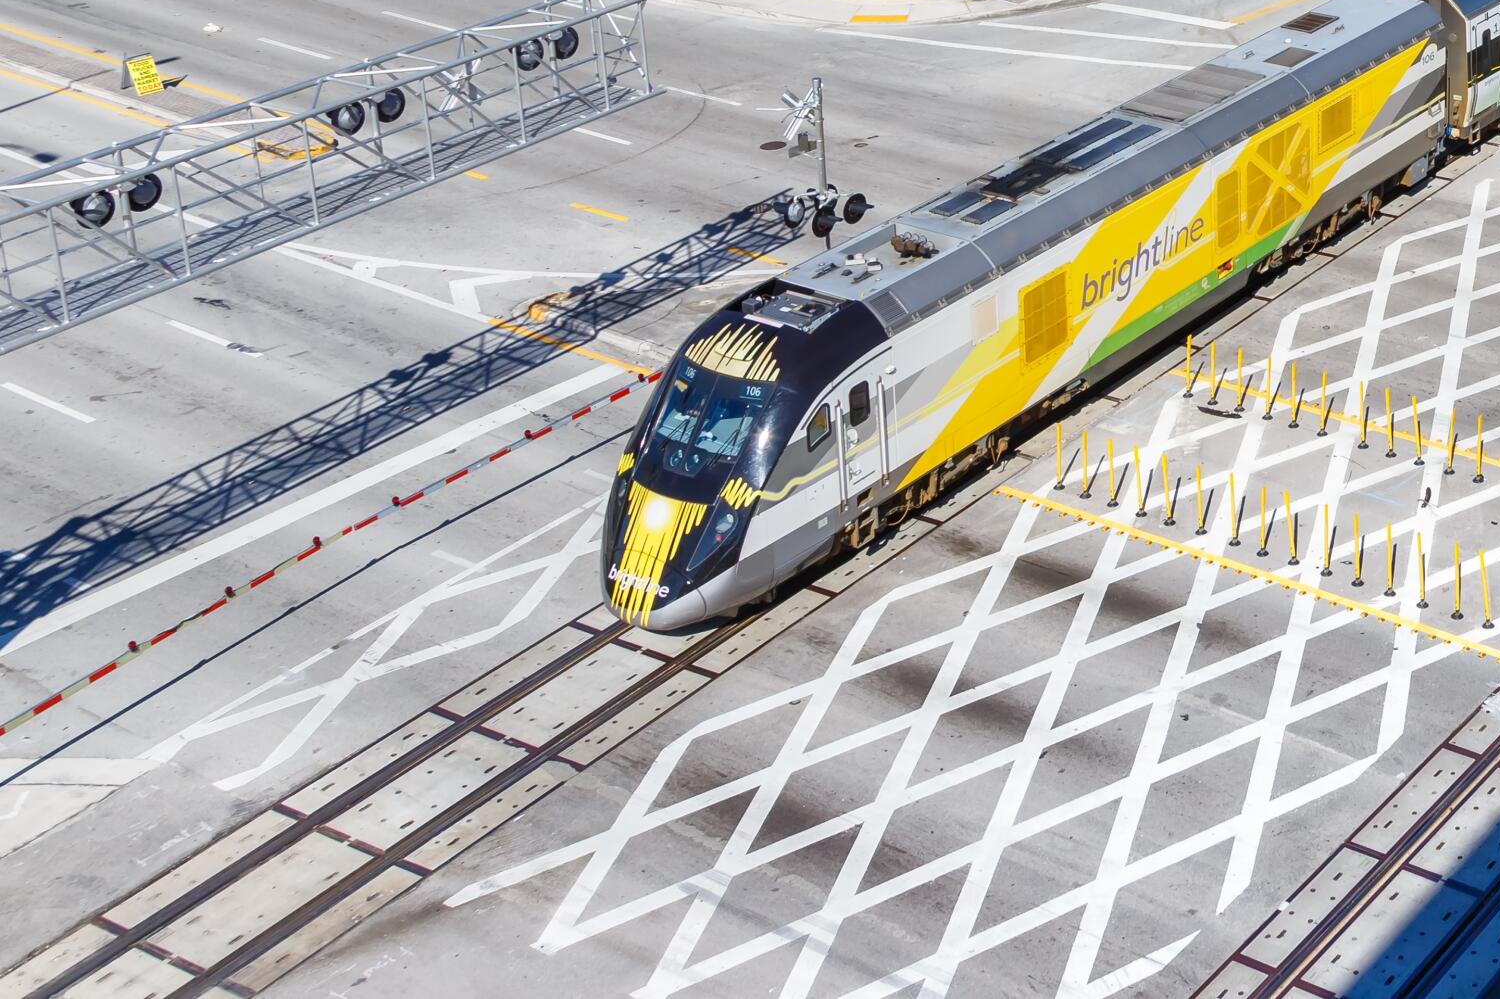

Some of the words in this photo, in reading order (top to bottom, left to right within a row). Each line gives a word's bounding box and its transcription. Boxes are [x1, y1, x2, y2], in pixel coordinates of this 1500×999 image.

[1422, 51, 1435, 66] 106
[138, 82, 162, 91] TODAY
[1080, 217, 1204, 310] brightline
[685, 366, 697, 379] 106
[746, 386, 762, 397] 106
[608, 563, 670, 598] brightline
